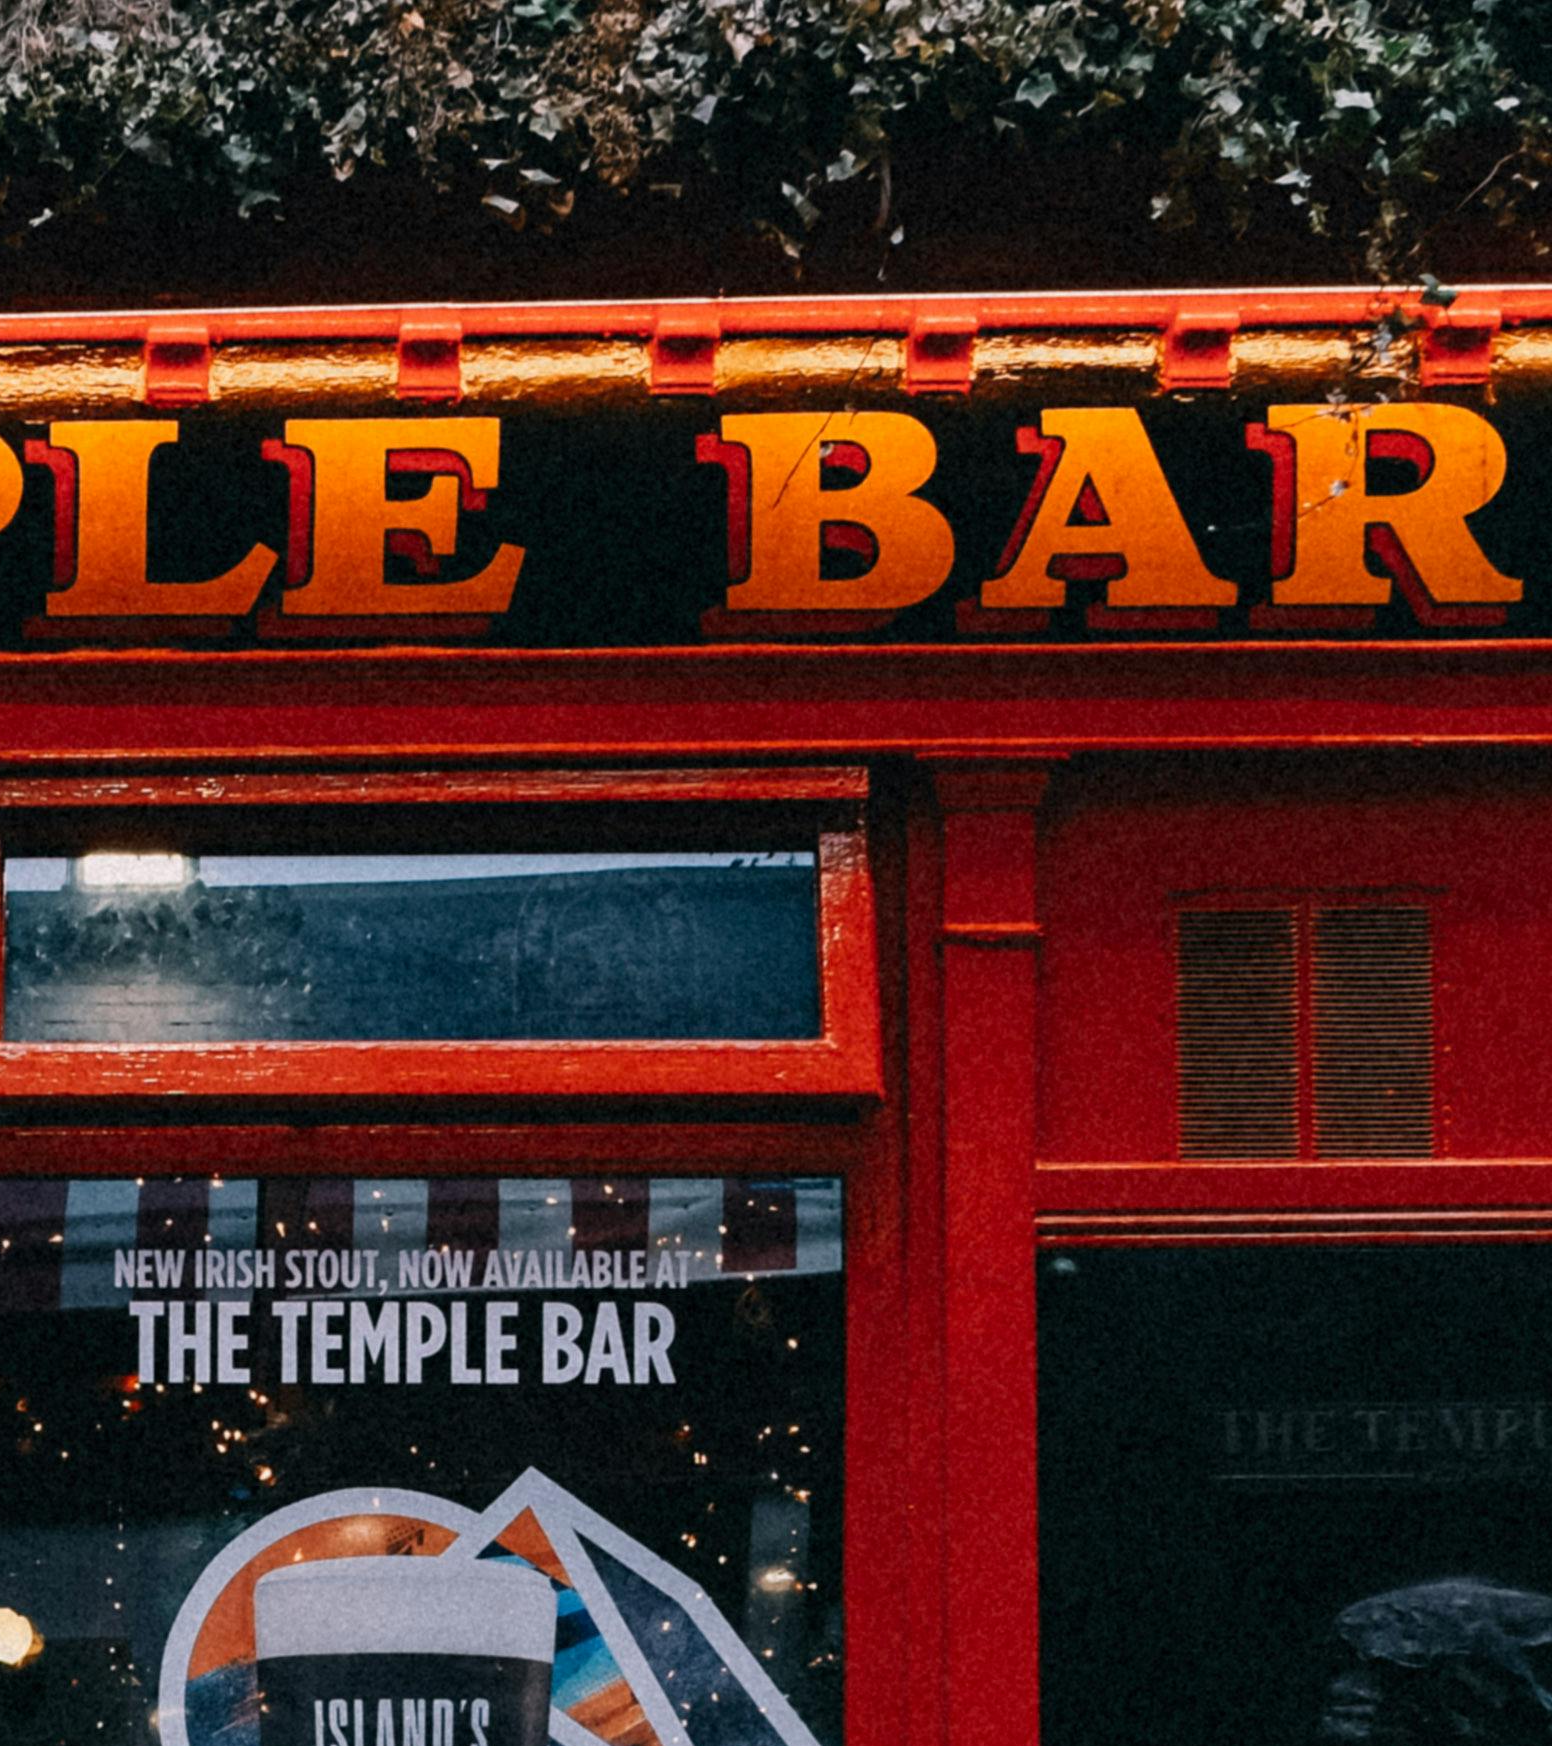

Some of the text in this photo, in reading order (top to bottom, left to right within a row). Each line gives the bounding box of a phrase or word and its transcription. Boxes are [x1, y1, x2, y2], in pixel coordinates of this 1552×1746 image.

[719, 403, 1523, 612] BAR
[113, 1249, 691, 1296] NEW IRISH STOUT, NOW AVAILABLE AT
[128, 1301, 676, 1384] THE TEMPLE BAR
[1220, 1408, 1338, 1455] THE
